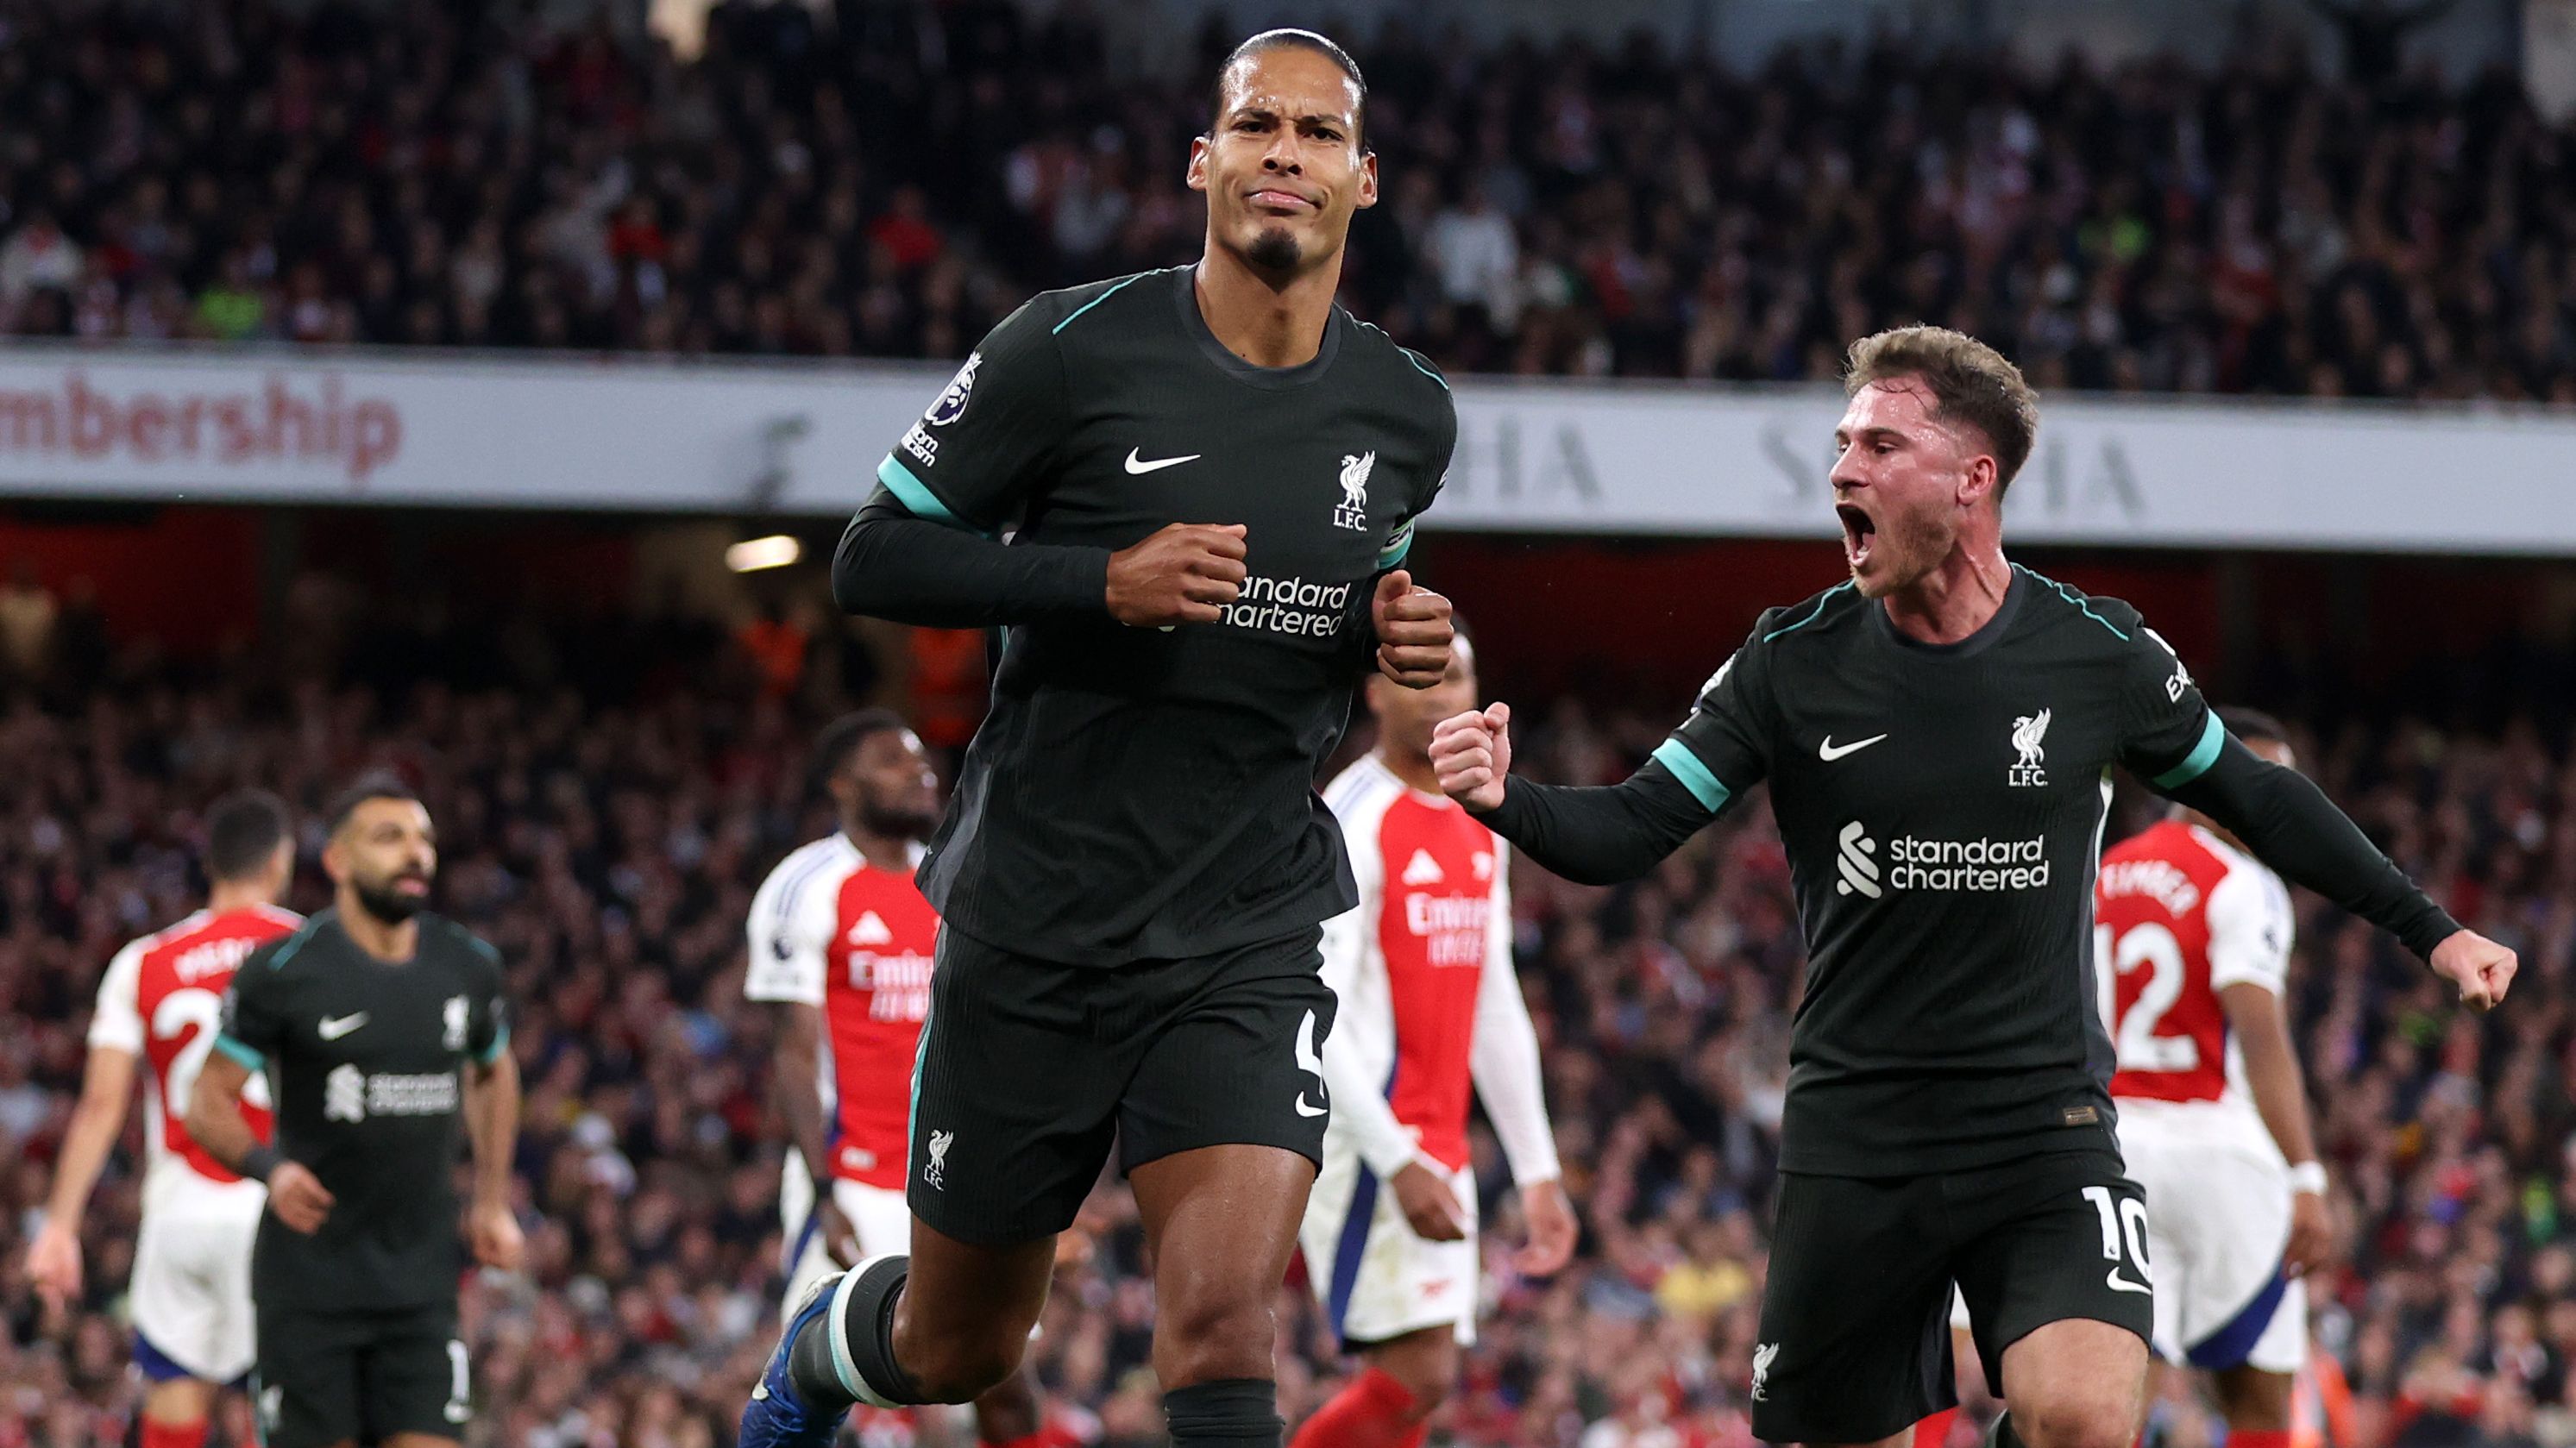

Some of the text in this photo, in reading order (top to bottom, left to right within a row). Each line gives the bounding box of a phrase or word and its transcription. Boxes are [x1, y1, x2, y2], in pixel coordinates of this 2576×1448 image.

[1332, 508, 1367, 531] L.F.C.
[1237, 575, 1351, 609] andard
[2007, 769, 2048, 787] L.F.C.
[1889, 834, 2045, 864] standard
[1889, 860, 2050, 891] chartered
[153, 987, 228, 1121] 2
[2081, 1186, 2153, 1283] 10
